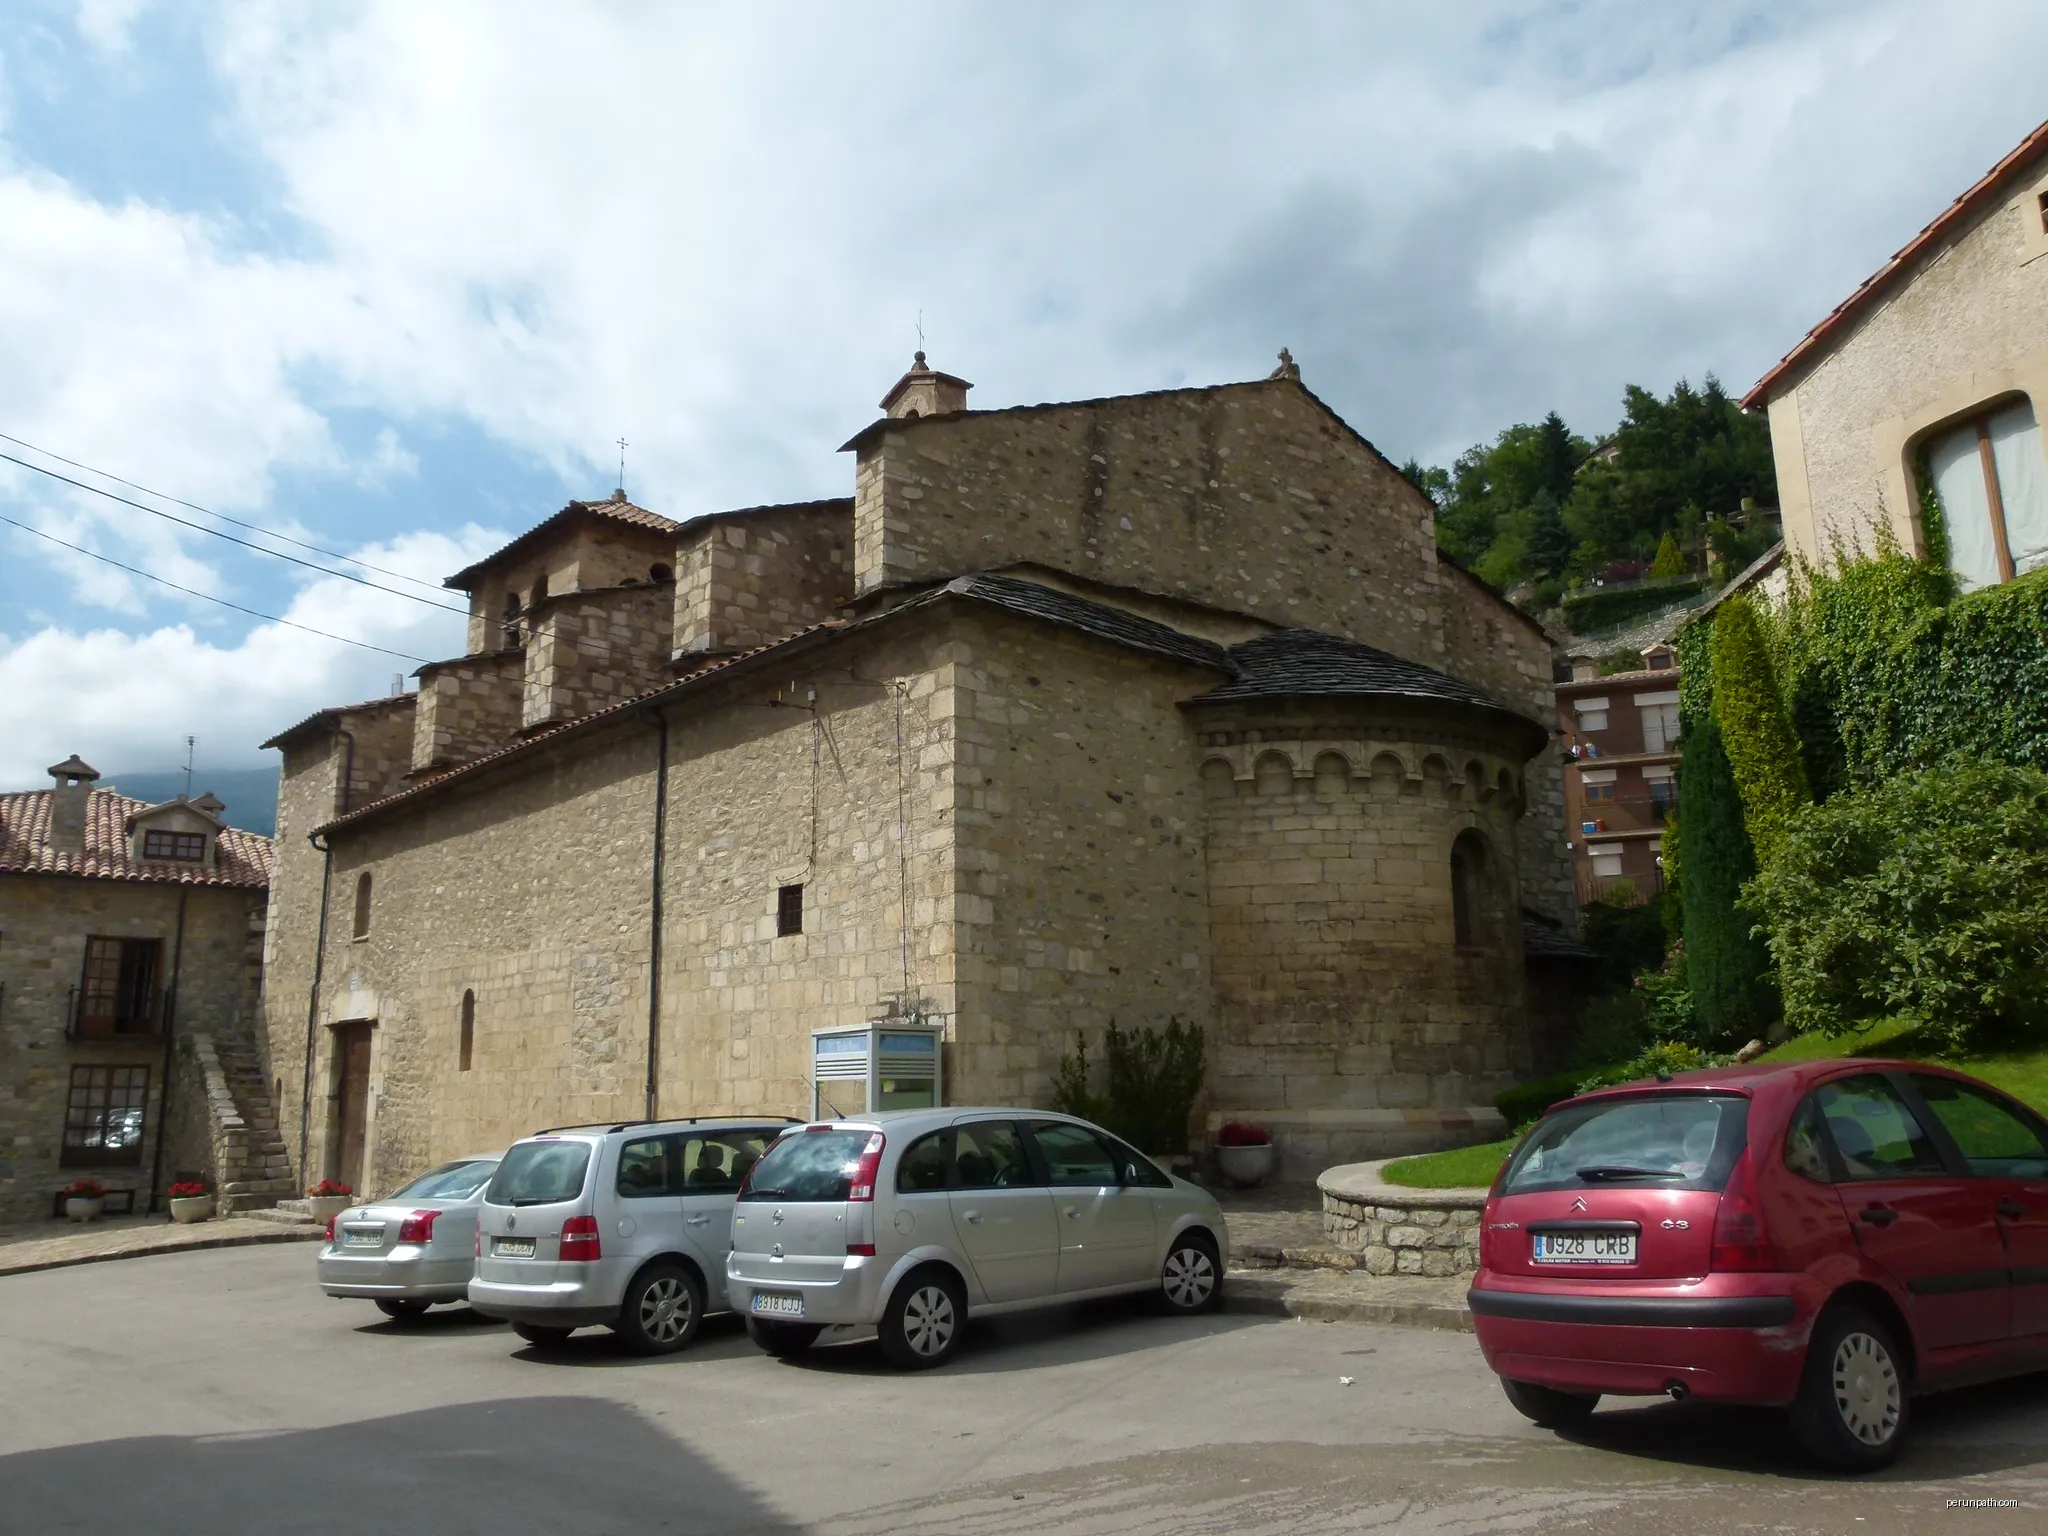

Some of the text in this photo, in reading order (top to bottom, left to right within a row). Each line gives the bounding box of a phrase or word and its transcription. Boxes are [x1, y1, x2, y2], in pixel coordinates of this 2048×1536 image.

[1660, 1218, 1690, 1230] C3
[1545, 1234, 1630, 1255] 0928 CRB
[758, 1295, 801, 1311] 8918 CJJ
